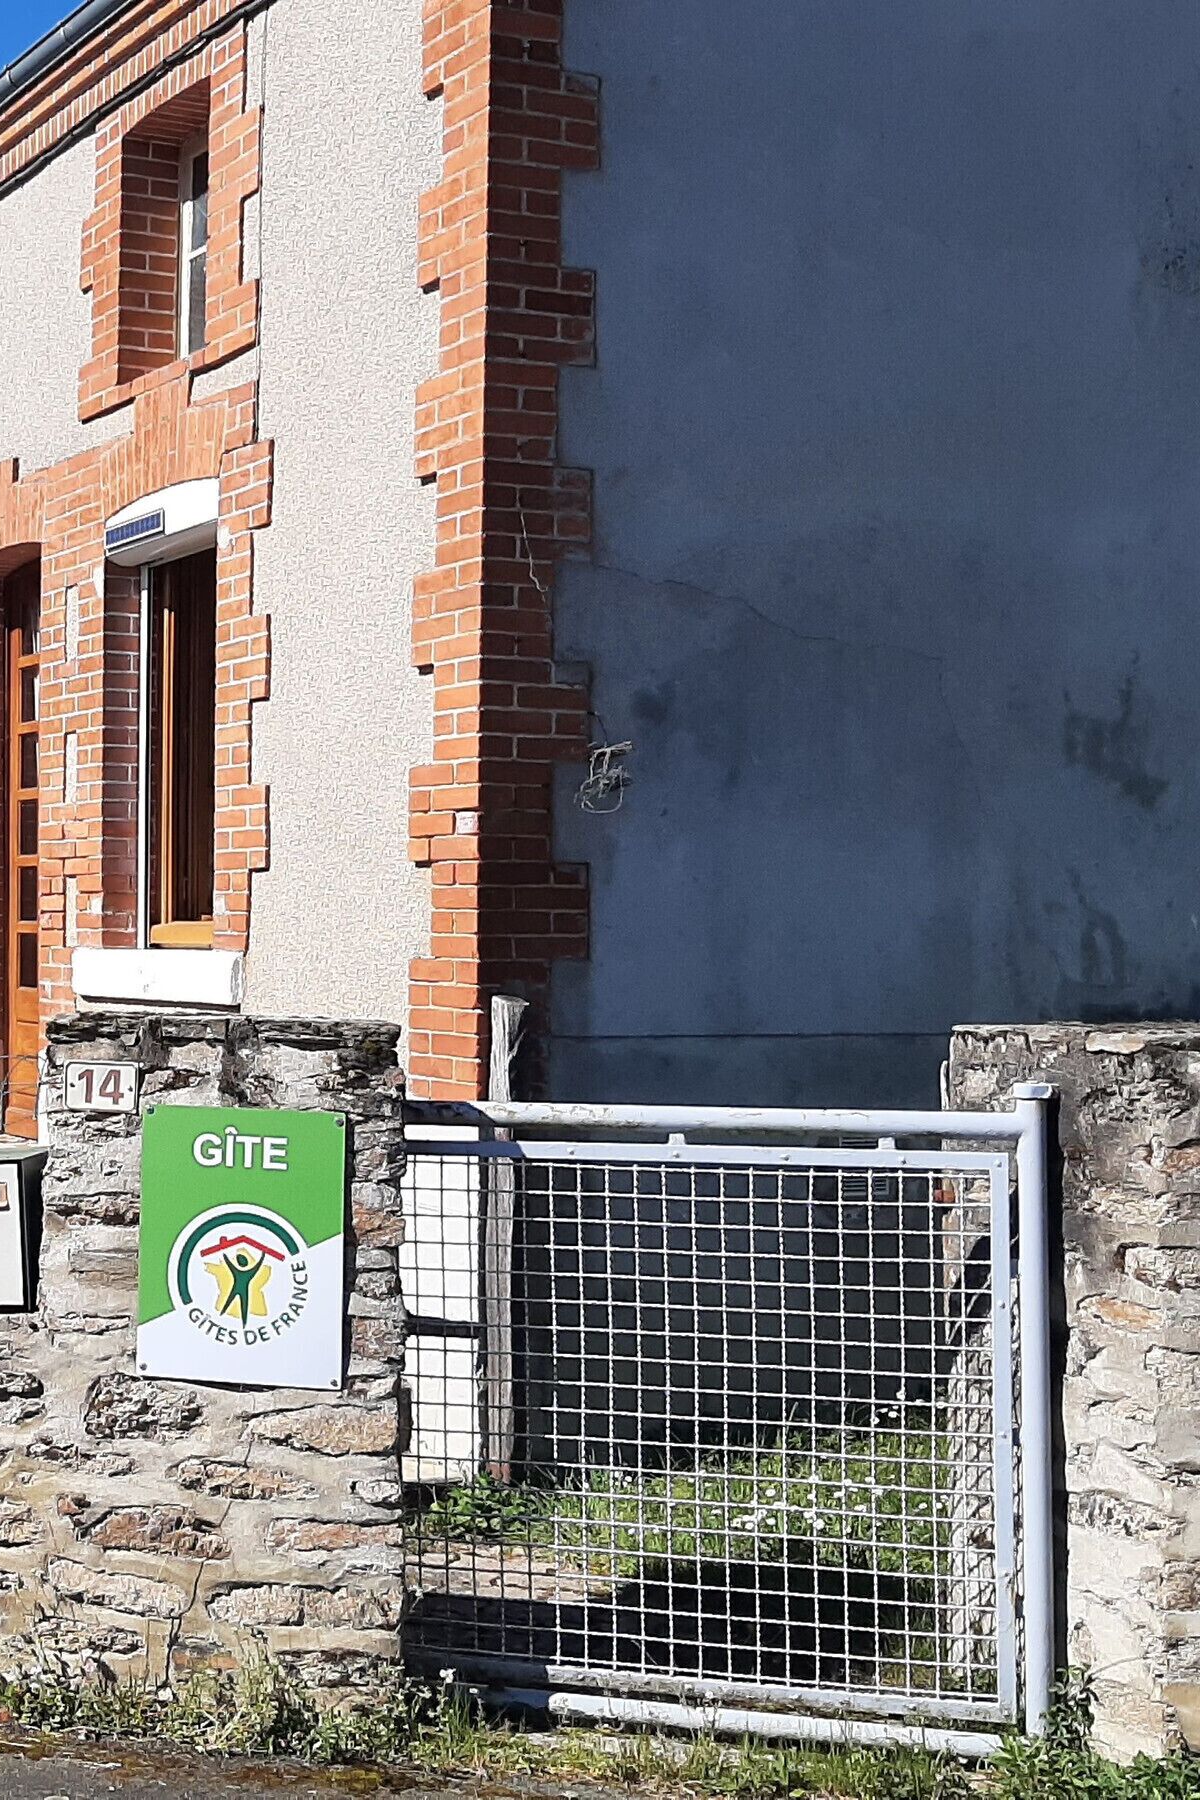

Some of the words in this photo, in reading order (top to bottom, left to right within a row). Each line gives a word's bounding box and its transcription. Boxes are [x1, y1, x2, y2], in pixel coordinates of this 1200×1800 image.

[78, 1069, 124, 1105] 14
[192, 1125, 288, 1170] GÎTE
[188, 1308, 238, 1345] GÎTES
[244, 1326, 271, 1345] DE
[271, 1260, 308, 1336] FRANCE
